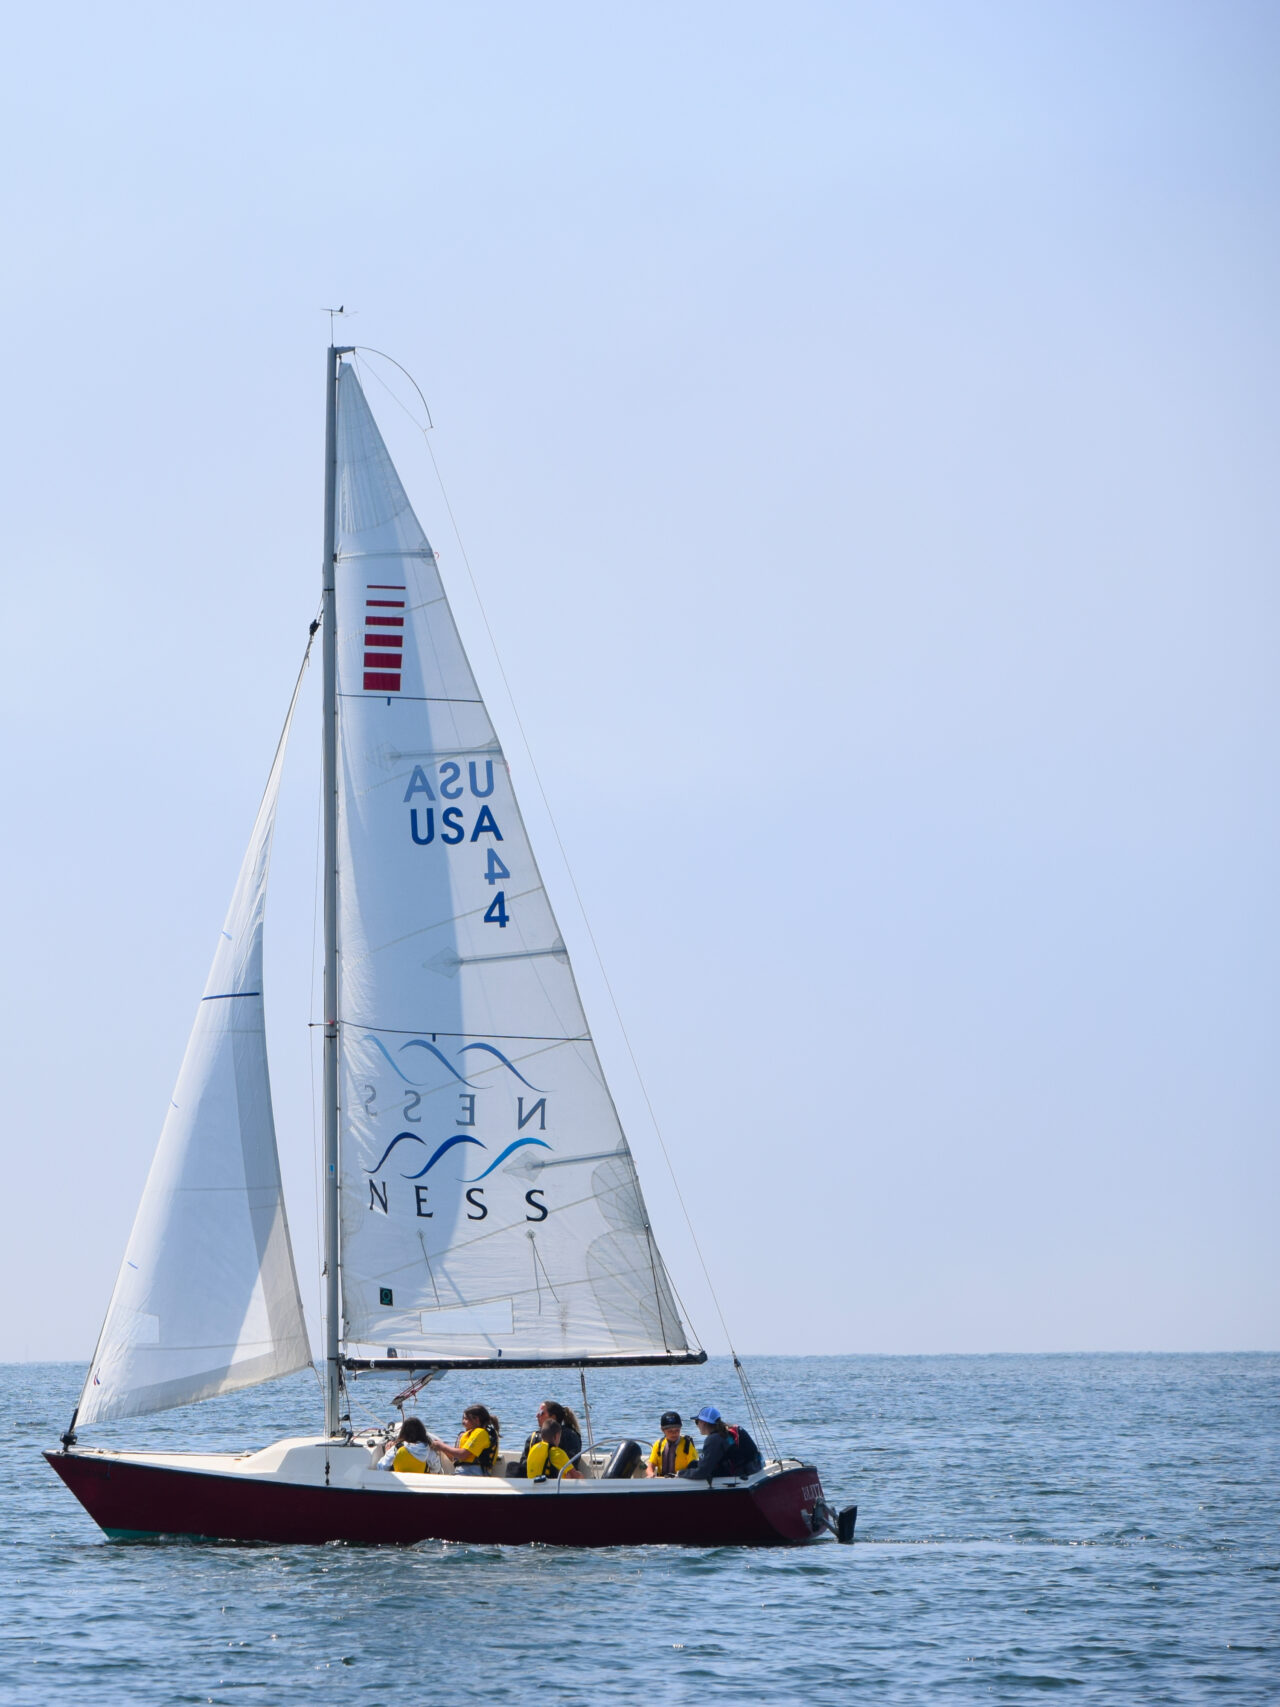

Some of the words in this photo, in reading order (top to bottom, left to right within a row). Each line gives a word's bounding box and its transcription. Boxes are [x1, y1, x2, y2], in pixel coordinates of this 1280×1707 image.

[410, 804, 504, 846] USA
[483, 890, 510, 929] 4
[368, 1178, 549, 1223] NESS
